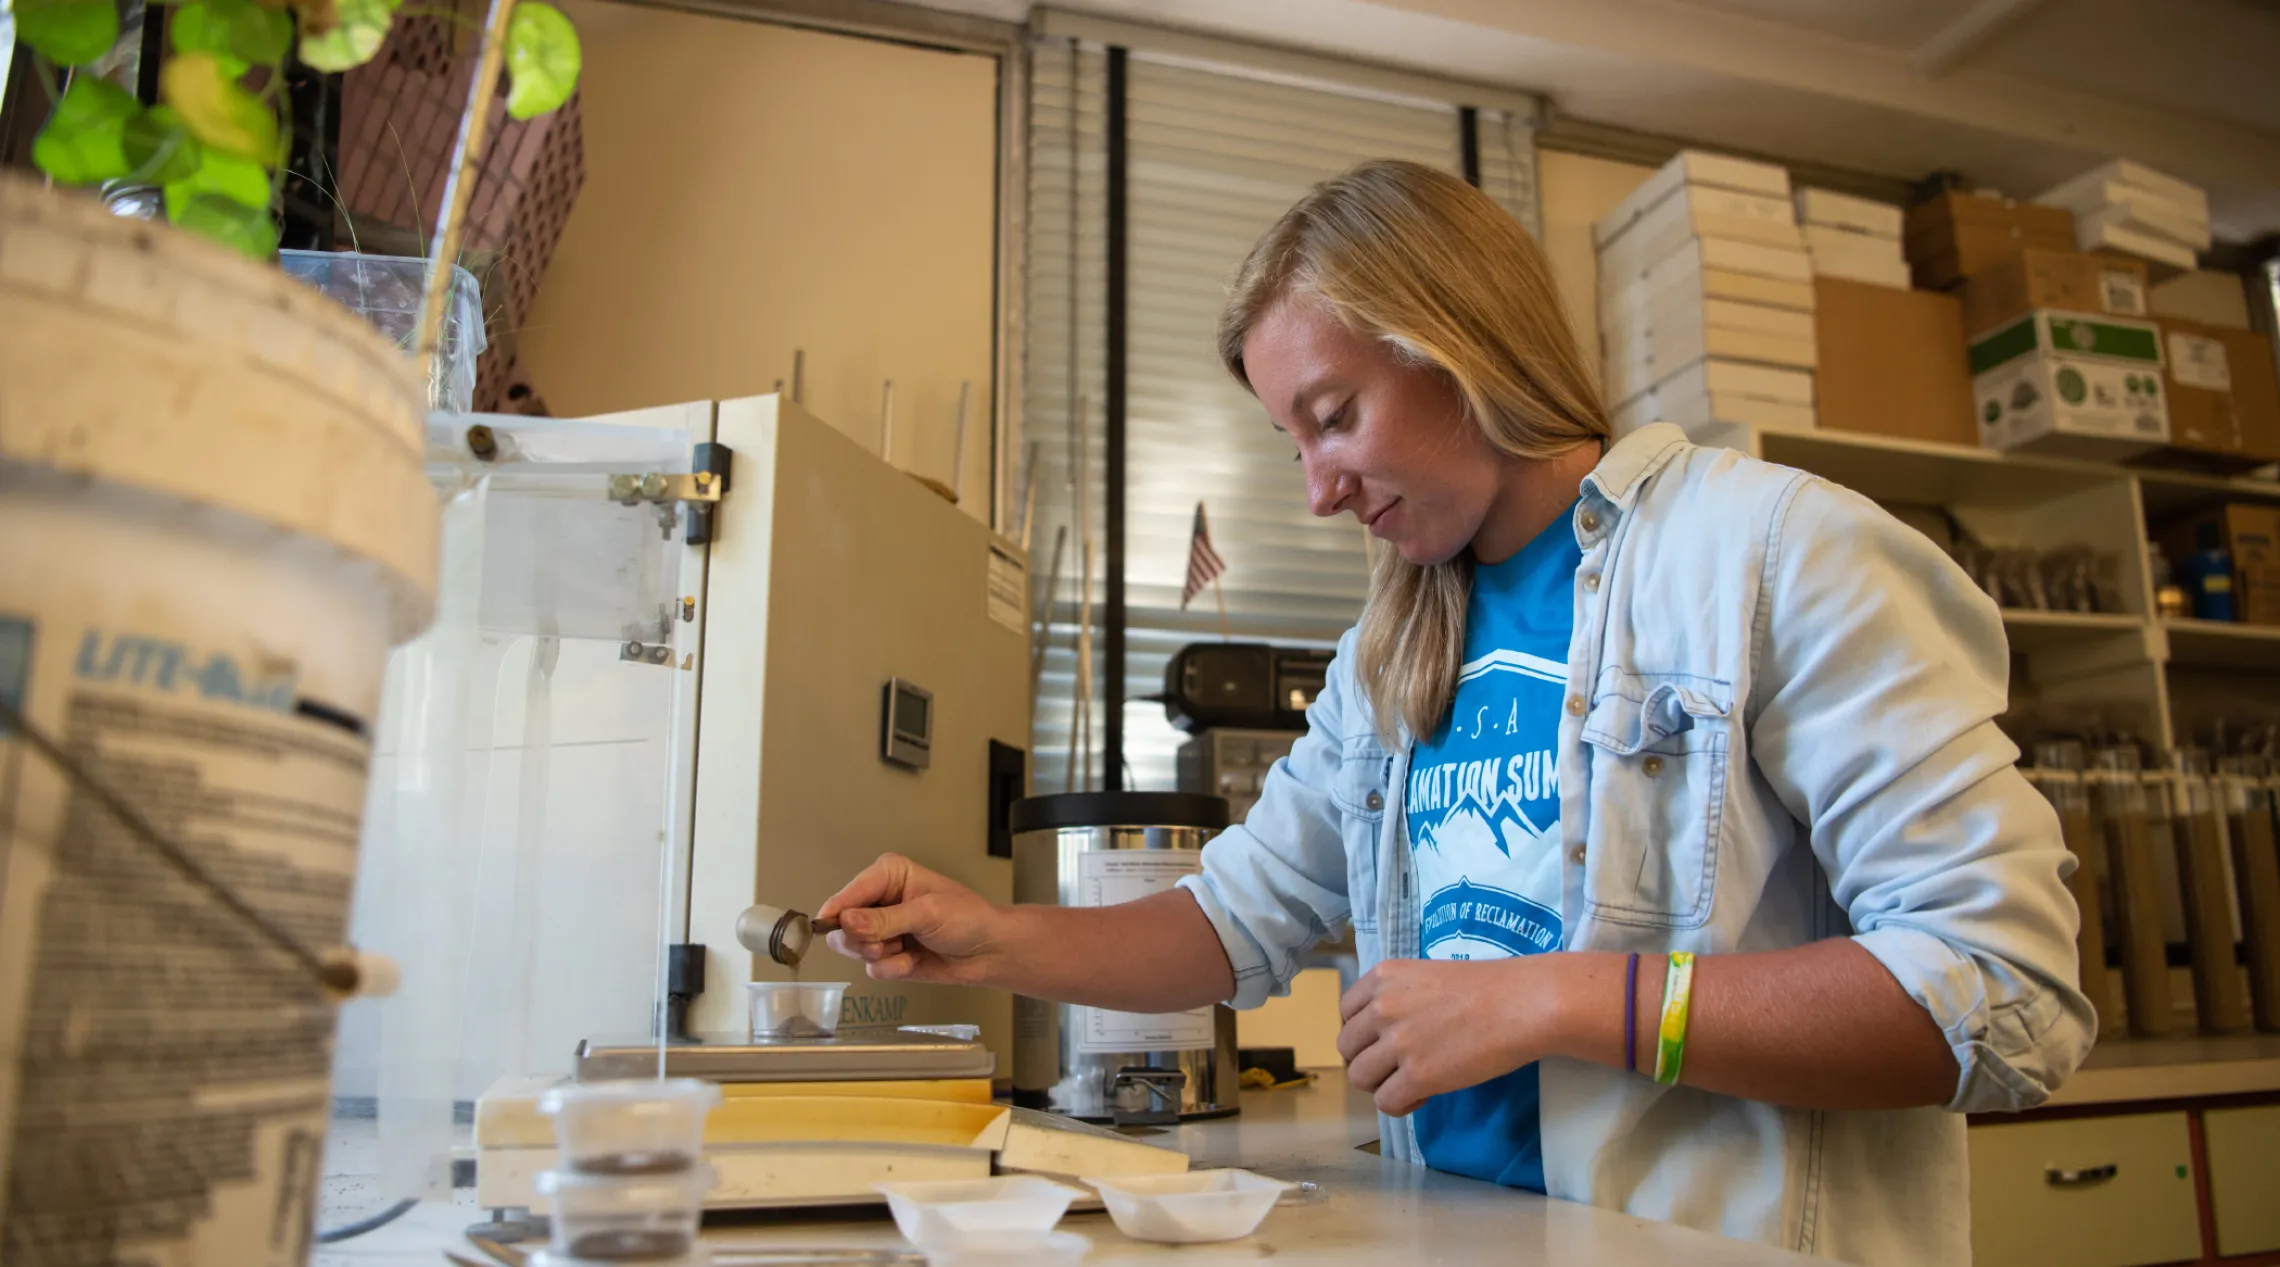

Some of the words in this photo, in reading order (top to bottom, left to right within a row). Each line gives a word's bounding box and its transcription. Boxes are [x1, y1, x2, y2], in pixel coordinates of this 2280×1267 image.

[1408, 757, 1502, 814] AMATION
[1460, 902, 1473, 919] OF
[1475, 902, 1554, 950] RECLAMATION
[840, 995, 908, 1024] ENKAMP
